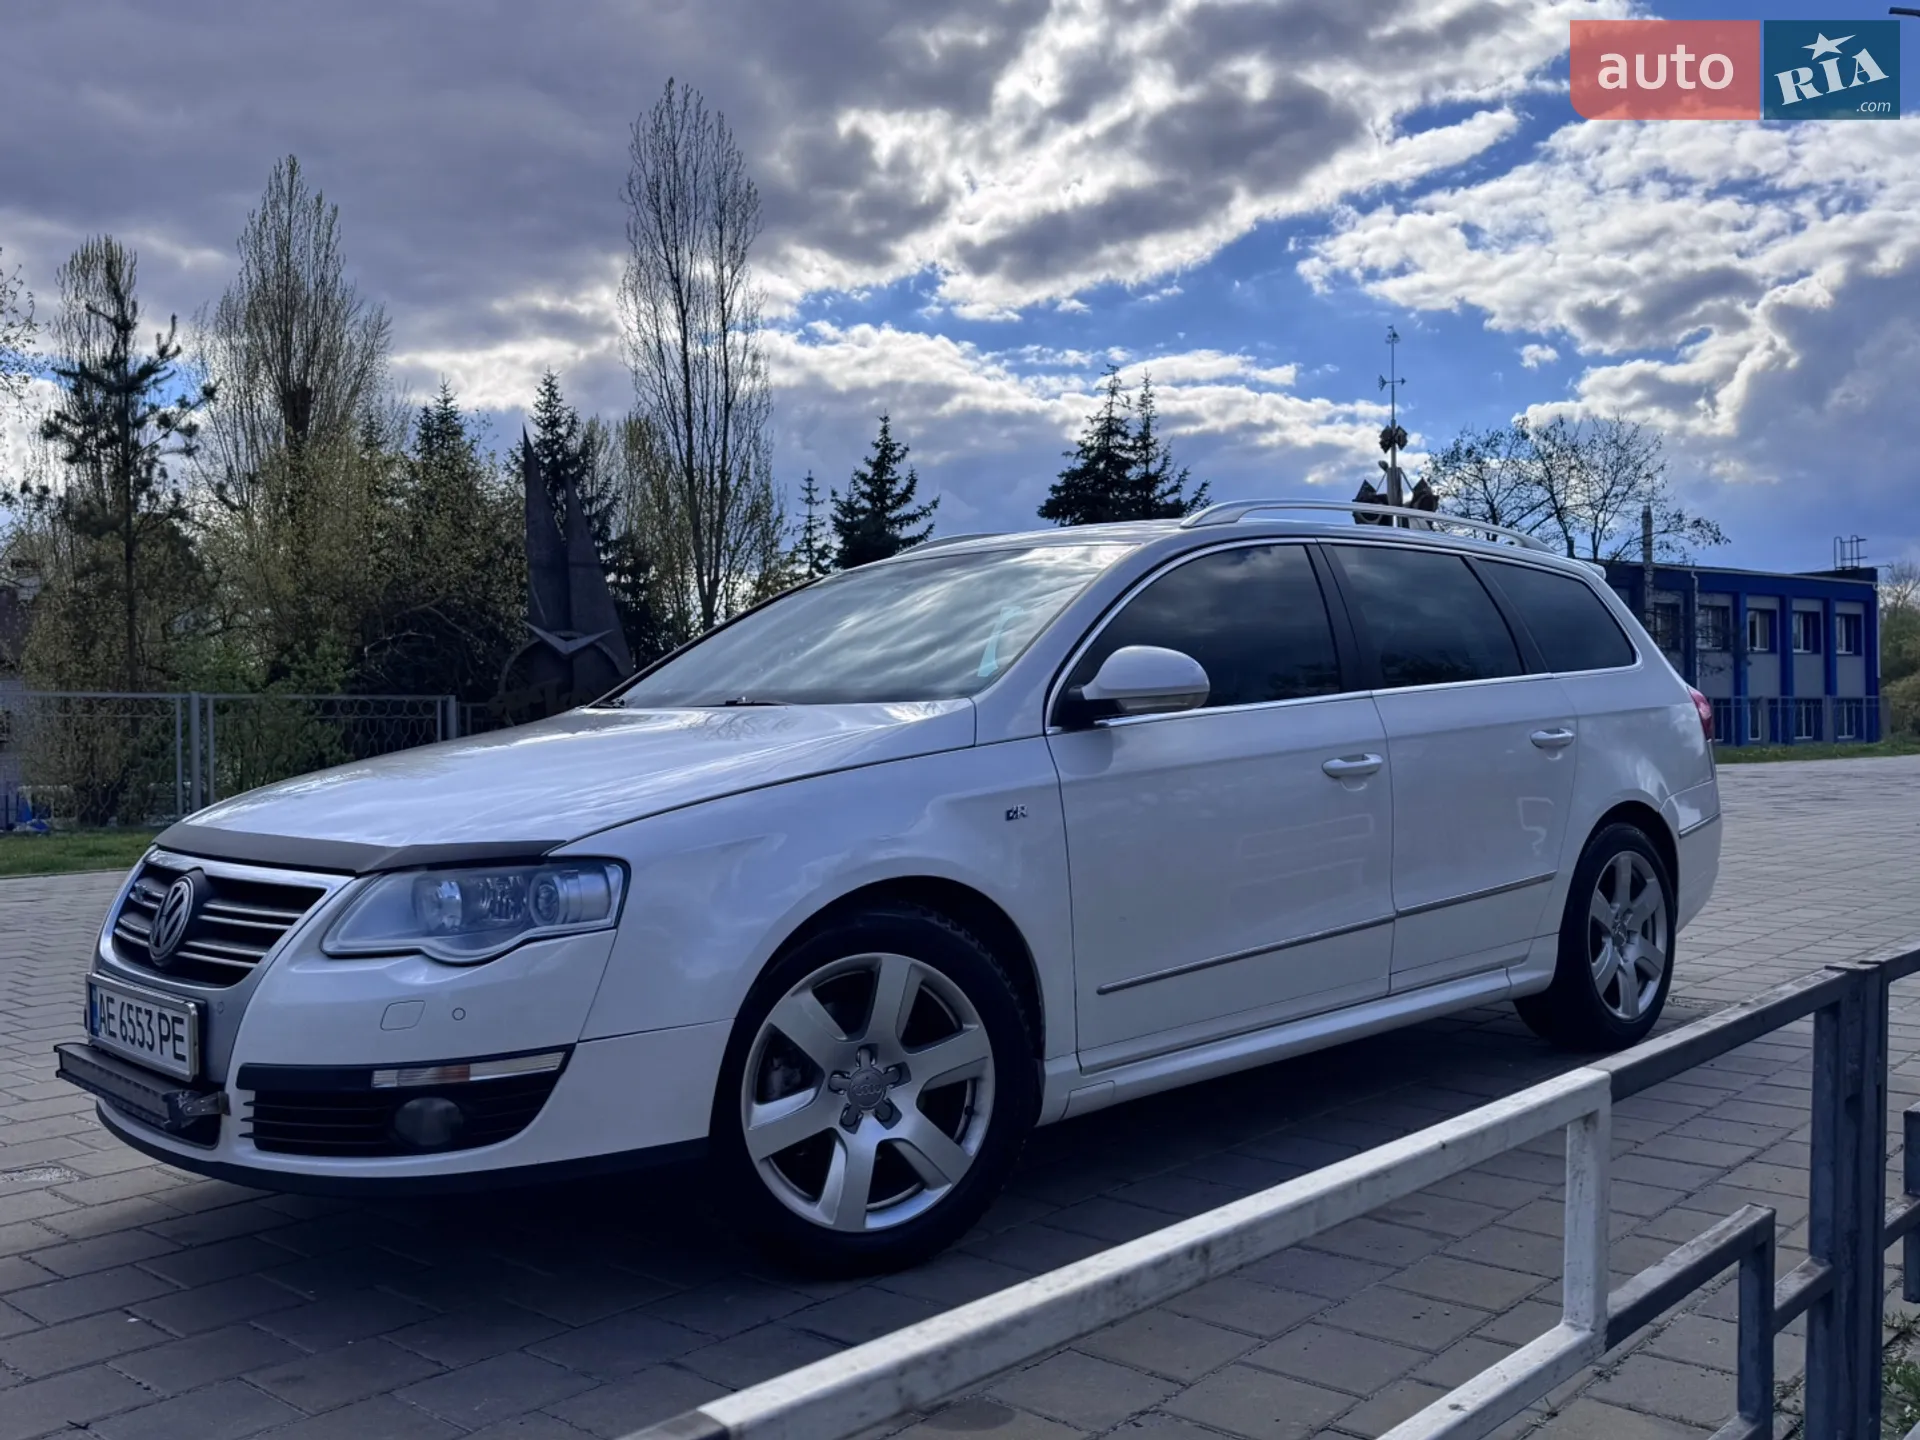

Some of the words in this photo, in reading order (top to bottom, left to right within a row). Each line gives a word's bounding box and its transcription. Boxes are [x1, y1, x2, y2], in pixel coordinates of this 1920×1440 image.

[99, 993, 117, 1038] AE
[119, 1001, 155, 1052] 6553
[157, 1011, 187, 1062] PE
